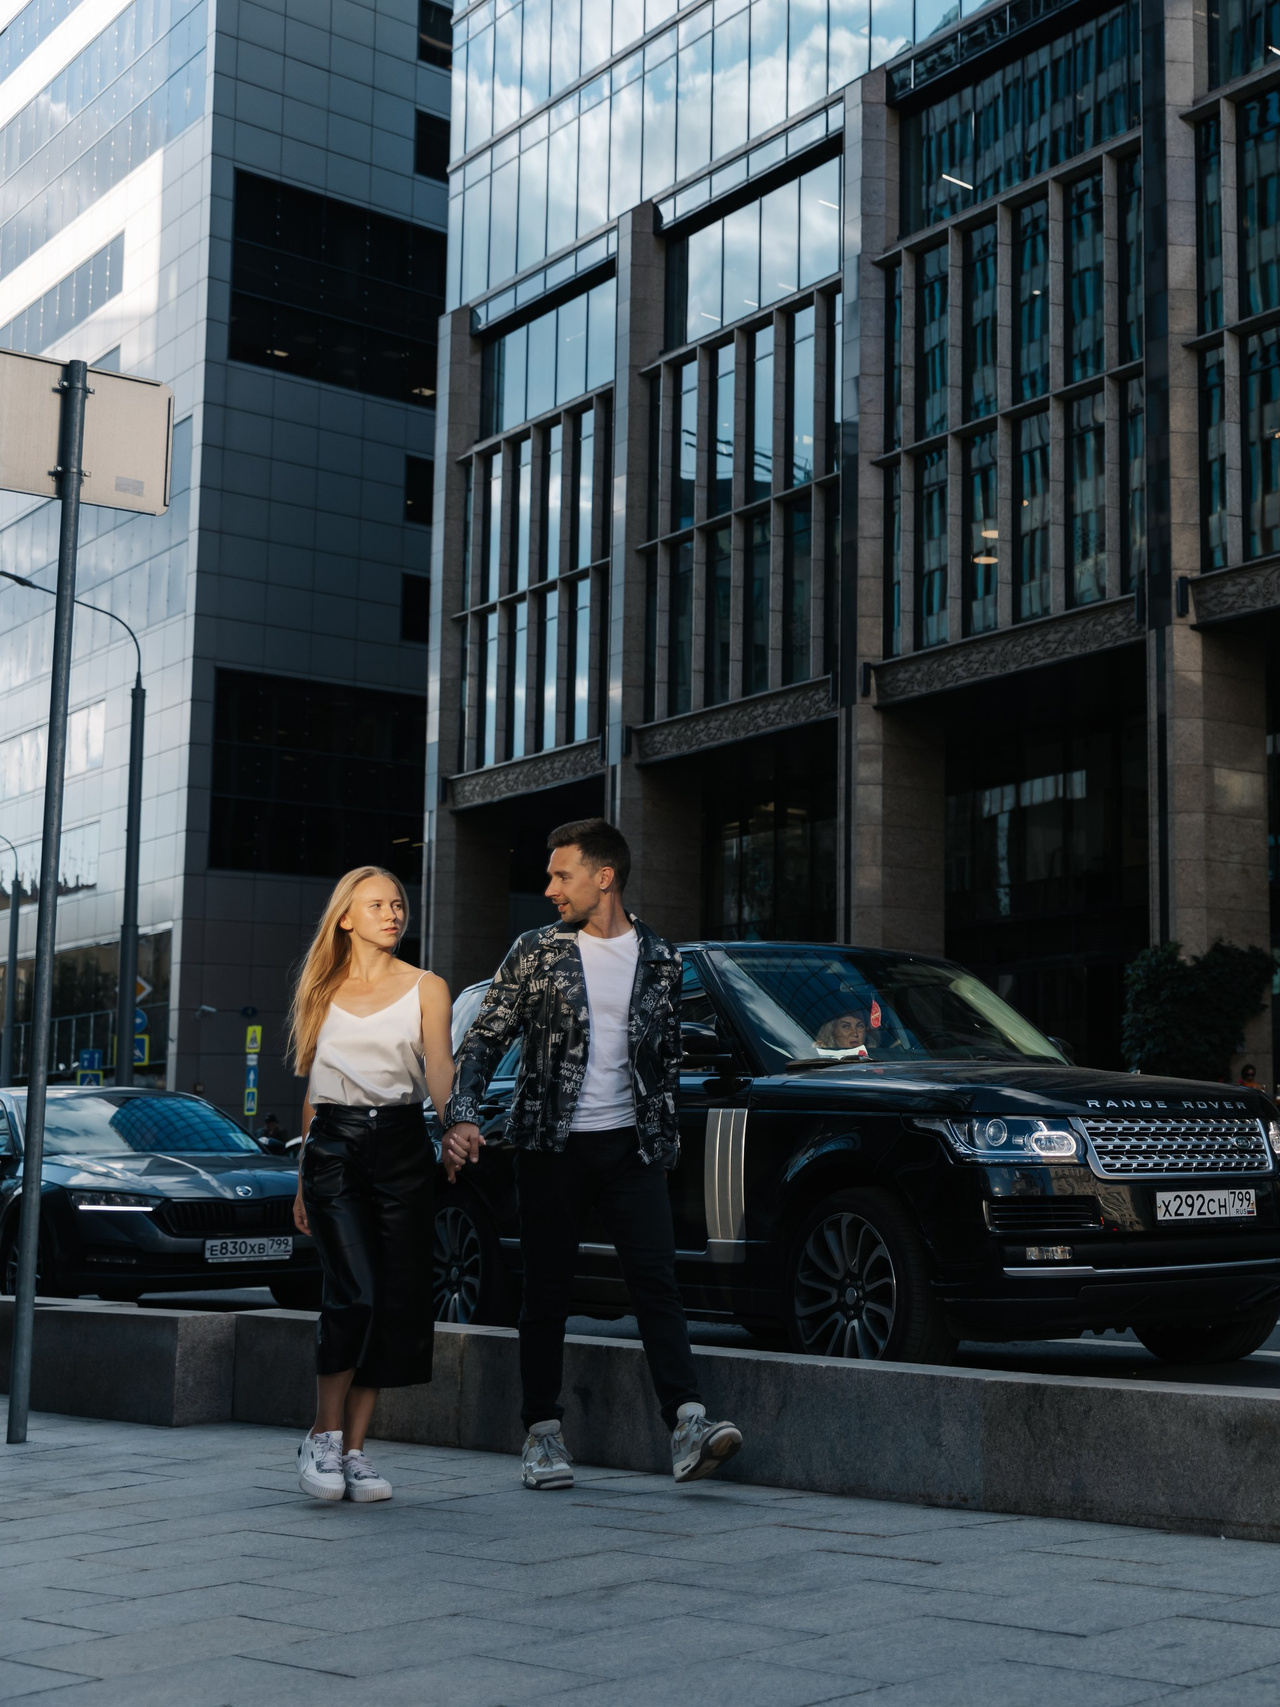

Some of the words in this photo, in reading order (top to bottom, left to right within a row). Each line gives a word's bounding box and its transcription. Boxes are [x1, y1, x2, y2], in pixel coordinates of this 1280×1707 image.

[1086, 1099, 1168, 1109] RANGE
[1182, 1101, 1248, 1110] ROVER
[1229, 1191, 1251, 1208] 799
[269, 1238, 289, 1250] 799
